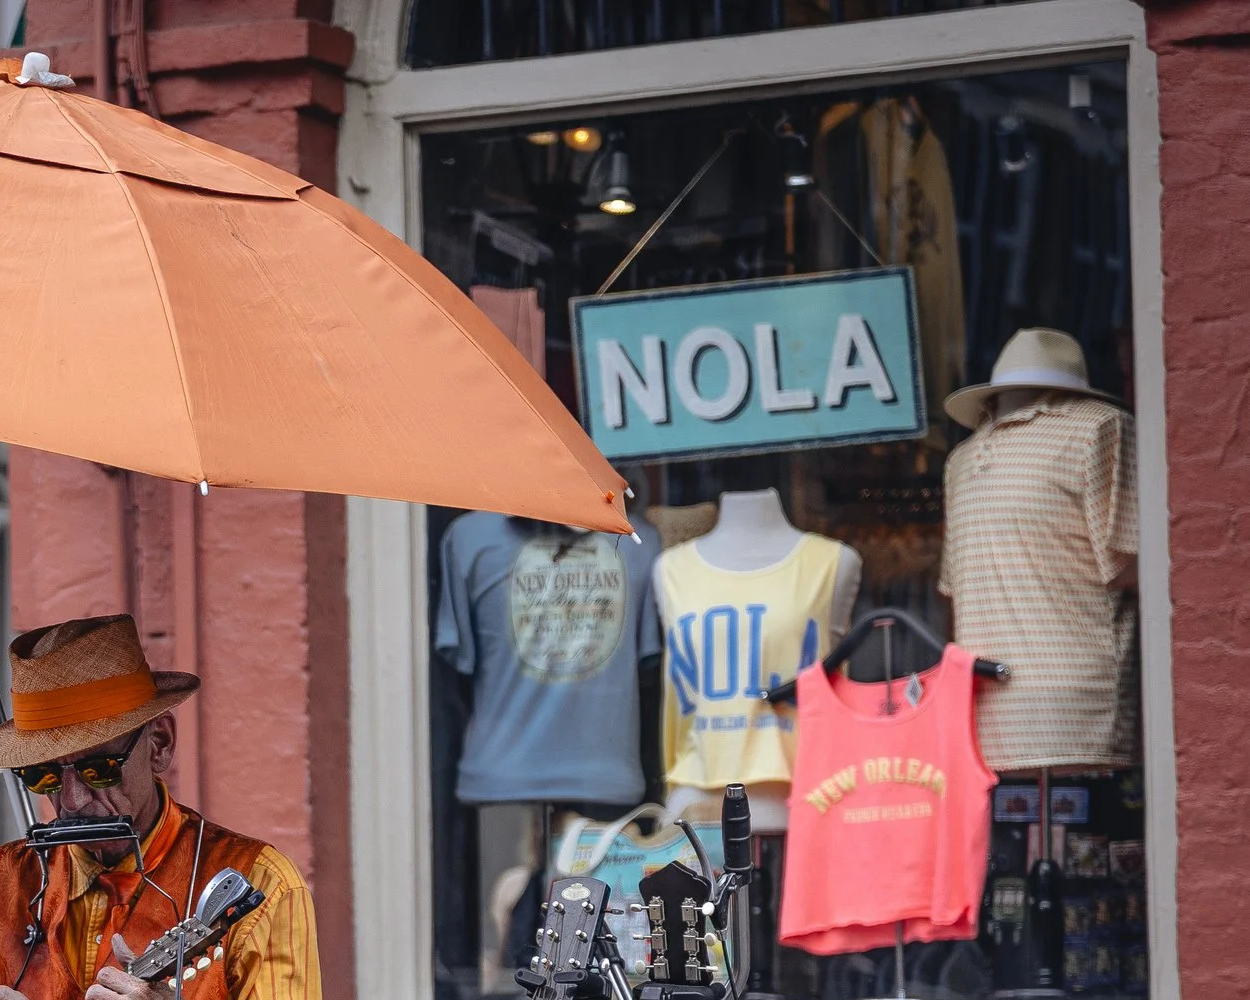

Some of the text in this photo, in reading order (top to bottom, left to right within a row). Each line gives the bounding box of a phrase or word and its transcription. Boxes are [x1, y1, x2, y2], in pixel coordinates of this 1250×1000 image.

[600, 313, 897, 429] NOLA
[805, 764, 858, 815] NEW
[863, 756, 947, 800] ORLEAN
